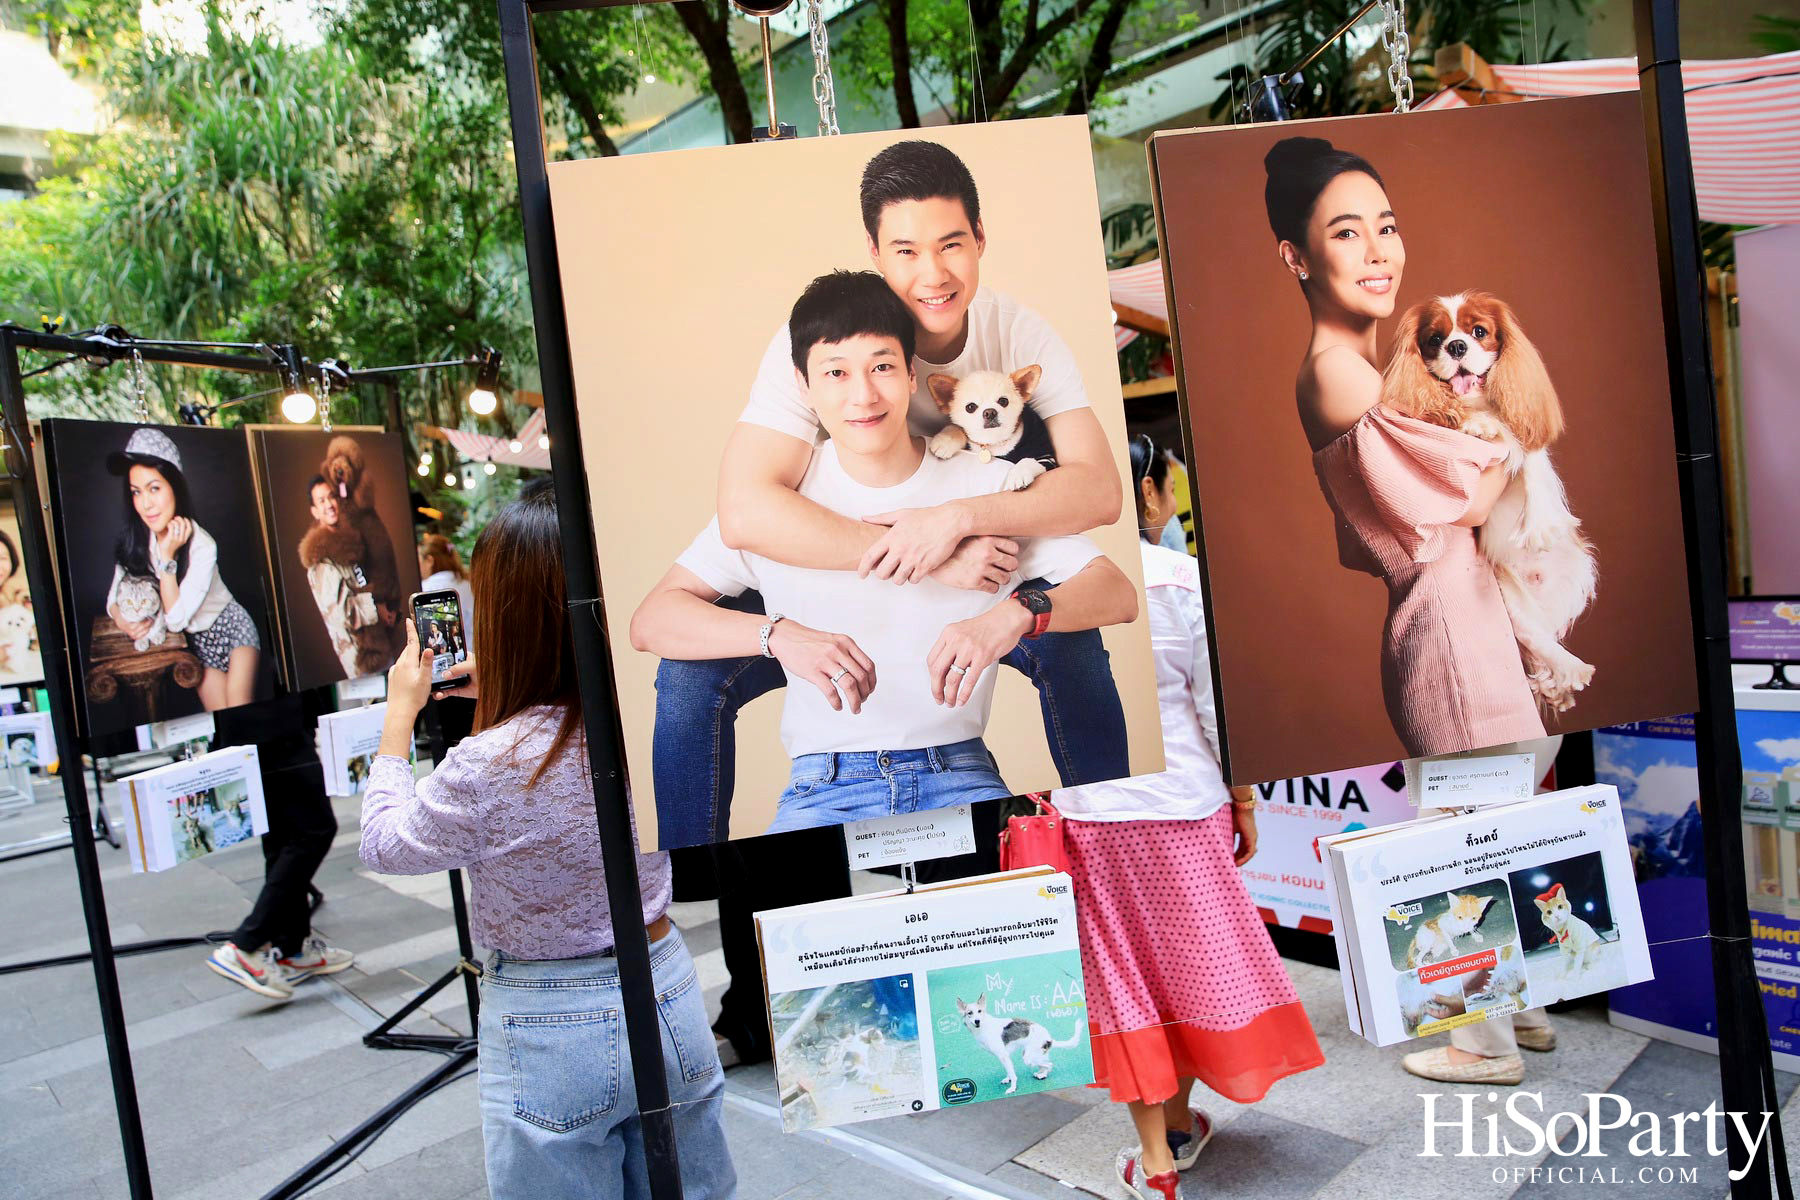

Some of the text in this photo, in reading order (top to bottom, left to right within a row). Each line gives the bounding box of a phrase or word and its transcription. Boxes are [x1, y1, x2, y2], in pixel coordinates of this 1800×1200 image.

[1268, 803, 1307, 817] SINCE
[1312, 809, 1342, 822] 1999
[855, 832, 876, 841] GUEST
[1046, 886, 1068, 894] VOICE
[1397, 904, 1421, 915] VOICE
[905, 912, 929, 924] เอเอ
[986, 972, 1014, 997] My
[994, 1000, 1026, 1014] Name
[1052, 979, 1085, 1006] AA
